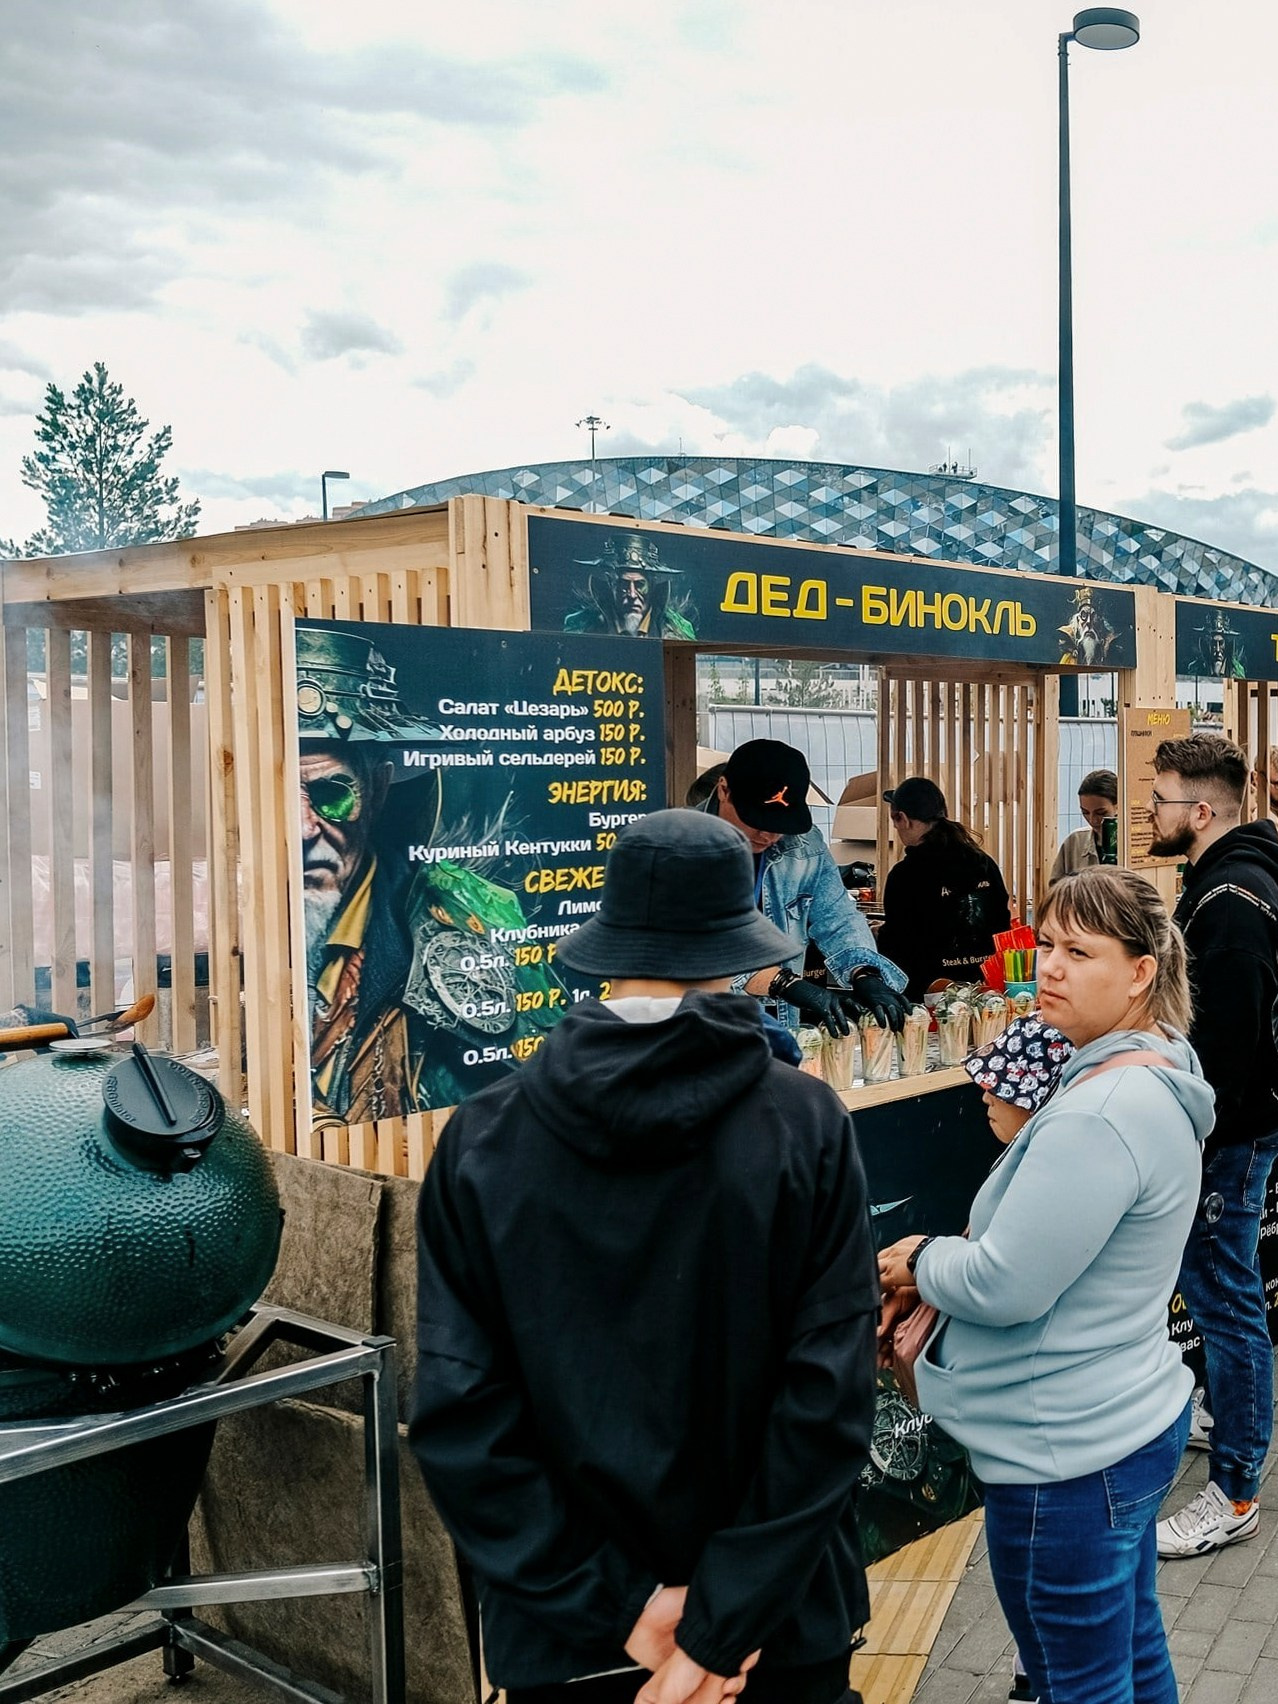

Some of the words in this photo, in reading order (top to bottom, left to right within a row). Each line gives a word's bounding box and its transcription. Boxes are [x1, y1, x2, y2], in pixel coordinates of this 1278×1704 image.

[720, 571, 827, 620] ДЕД
[861, 584, 1037, 637] БИНОКЛЬ
[553, 669, 644, 696] ДЕТОКС:
[438, 699, 499, 716] Салат
[504, 700, 589, 719] «Цезарь»
[593, 700, 624, 718] 500
[629, 700, 645, 718] Р.
[1147, 713, 1171, 726] МЕНЮ
[440, 725, 538, 742] Холодный
[543, 727, 595, 744] арбуз
[600, 724, 625, 742] 150
[629, 724, 646, 742] Р.
[403, 750, 494, 769] Игривый
[498, 750, 596, 767] сельдерей
[600, 748, 625, 766] 150
[629, 748, 646, 766] Р.
[548, 779, 647, 804] ЭНЕРГИЯ:
[408, 841, 499, 863] Куриный
[505, 840, 591, 857] Кентукки
[596, 832, 617, 851] 50
[524, 866, 605, 893] СВЕЖЕ
[514, 946, 542, 966] 150
[942, 958, 961, 967] Steak
[963, 957, 969, 965] &
[516, 991, 544, 1011] 150
[549, 988, 566, 1008] Р.
[463, 1047, 513, 1065] 0.5л.
[1177, 1336, 1200, 1353] вас
